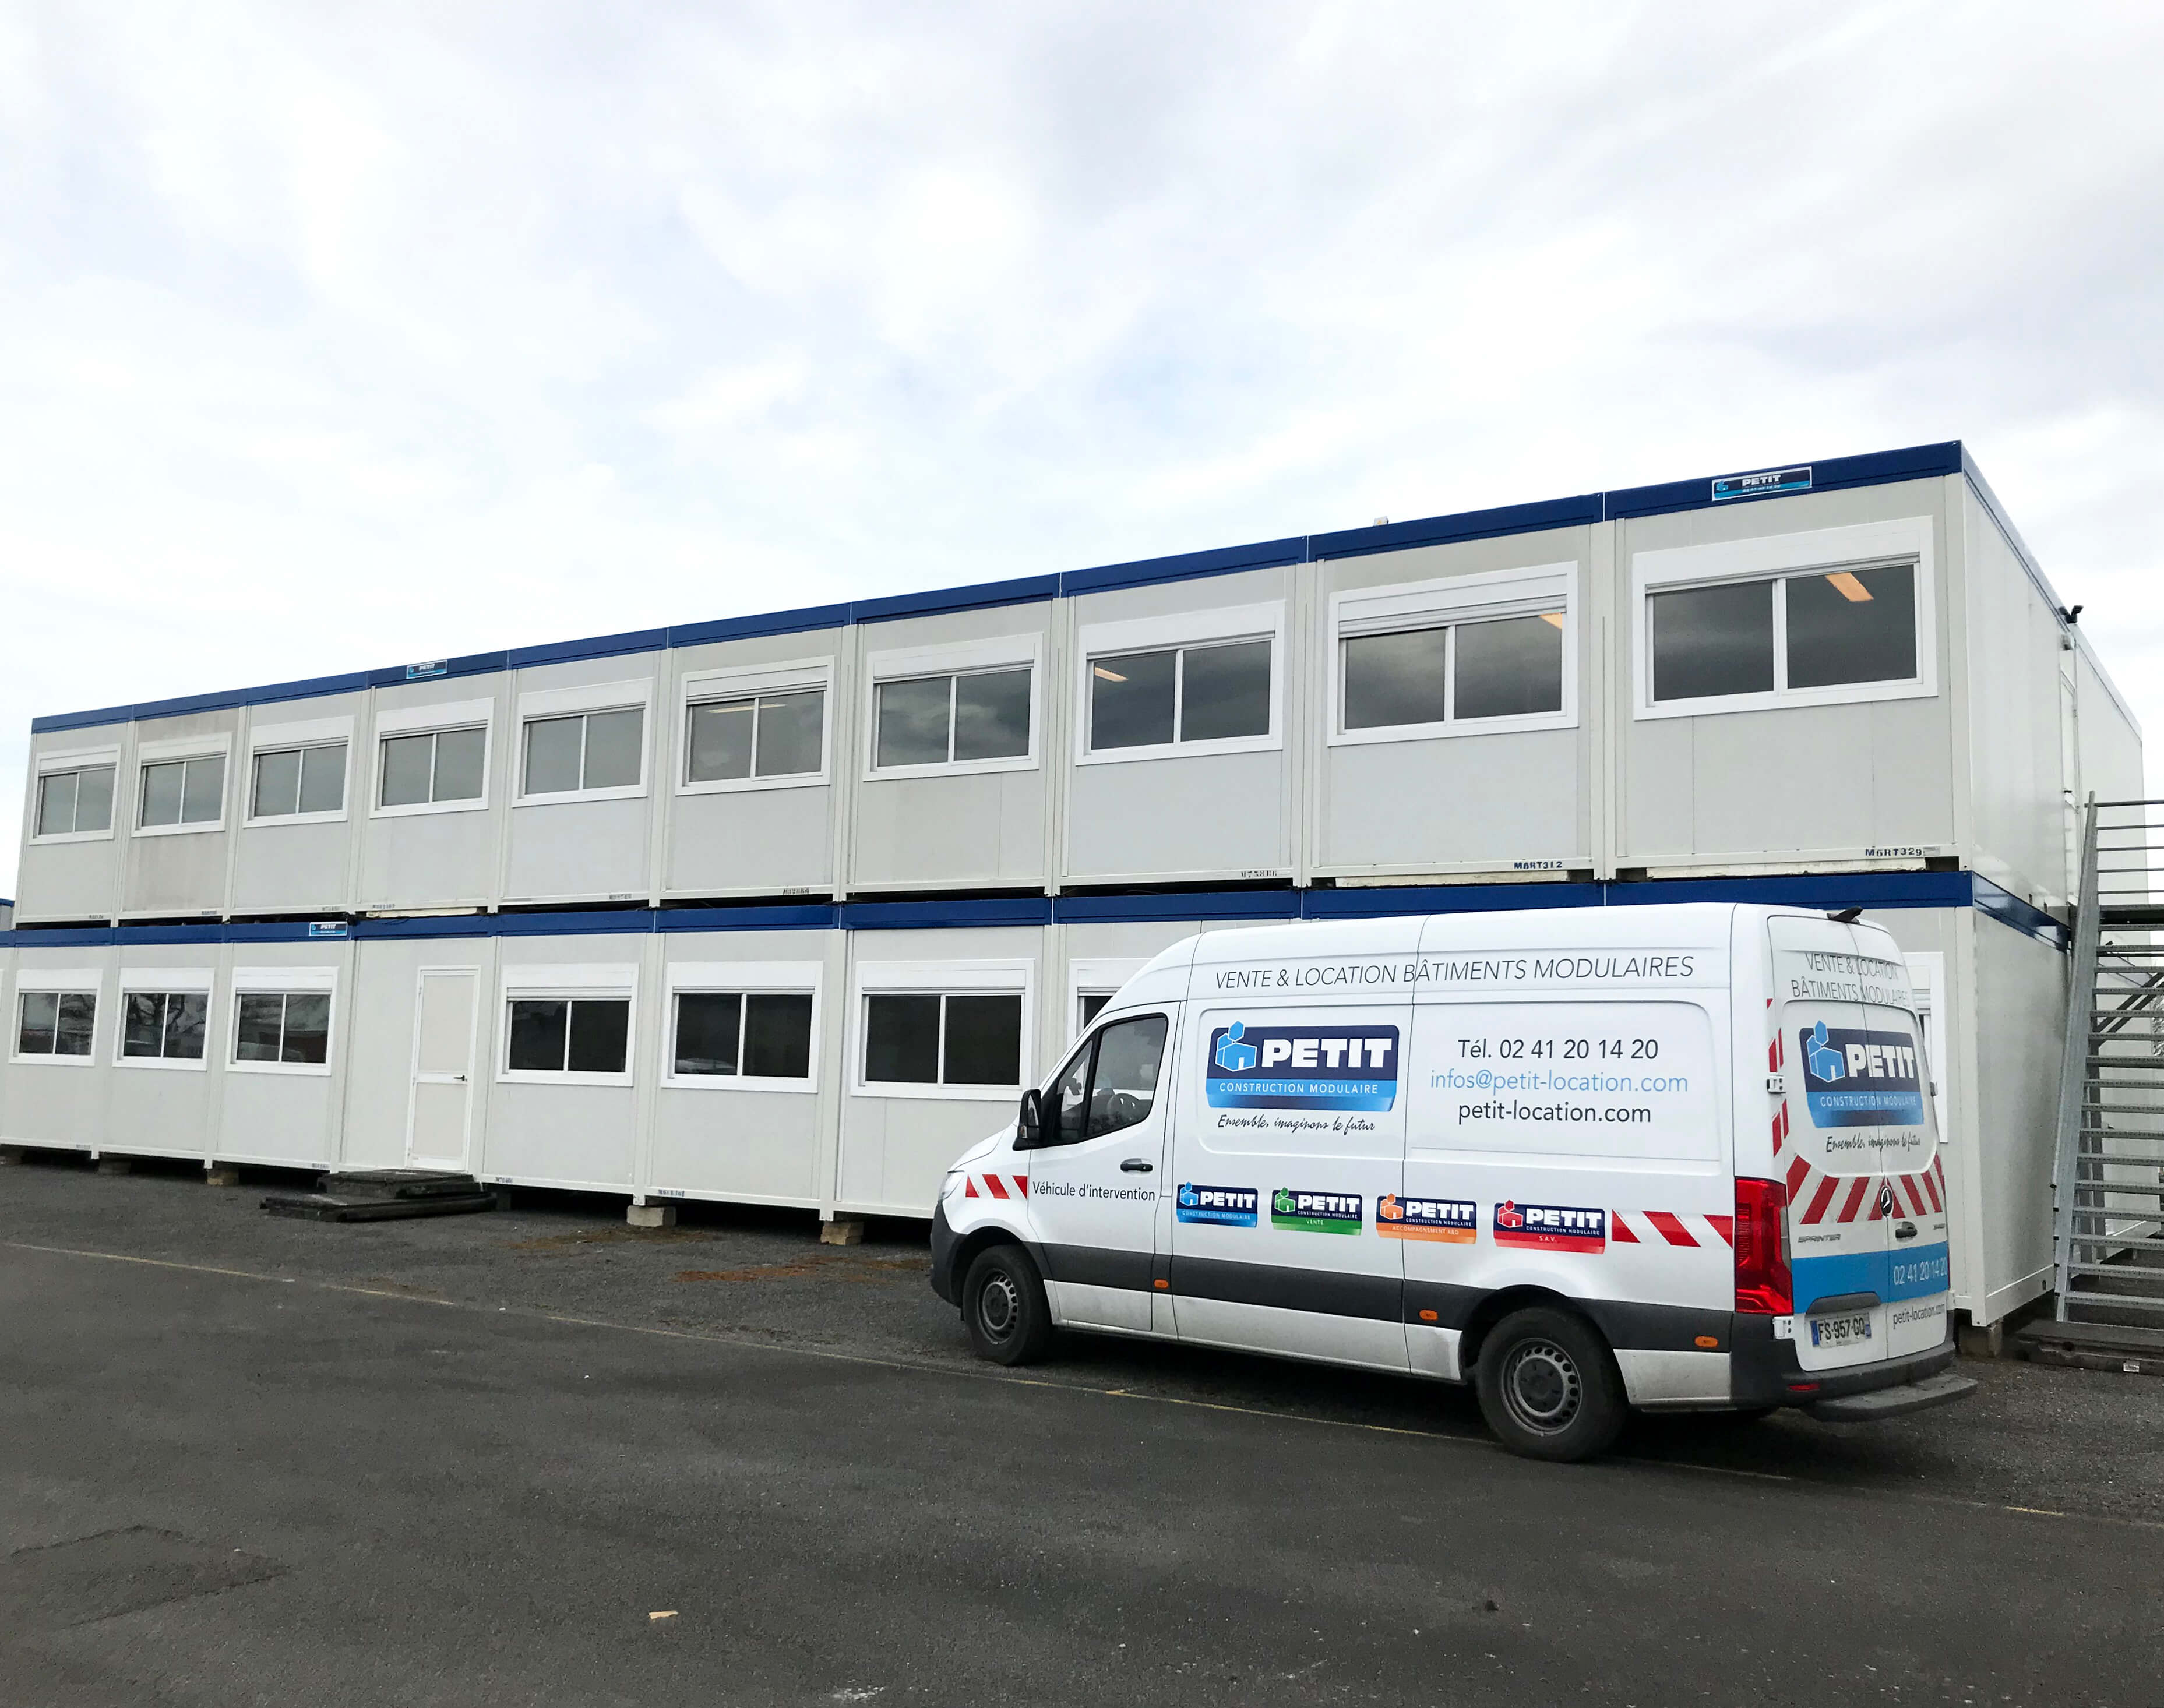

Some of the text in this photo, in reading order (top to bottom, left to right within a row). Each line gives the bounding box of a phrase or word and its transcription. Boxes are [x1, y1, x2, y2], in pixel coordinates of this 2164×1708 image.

[1742, 475, 1781, 486] PETIT
[1216, 955, 1695, 989] VENTE & LOCATION BÂTIMENTS MODULAIRES
[1805, 952, 1899, 979] VENTE & LOCATION
[1791, 976, 1859, 1002] BÂTIMENTS
[1261, 1037, 1393, 1068] PETIT
[1458, 1039, 1659, 1059] Tél. 02 41 20 14 20
[1845, 1043, 1915, 1078] PETIT
[1220, 1082, 1379, 1095] CONSTRUCTION MODULAIRE
[1430, 1068, 1689, 1096] infos@petit-location.com
[1820, 1096, 1882, 1107] CONSTRUCTION
[1458, 1100, 1651, 1125] petit-location.com
[1217, 1113, 1376, 1136] Ensemble, imaginons le futur
[1032, 1181, 1155, 1201] Véhicule d'intervention
[1200, 1191, 1256, 1208] PETIT
[1298, 1194, 1361, 1213] PETIT
[1405, 1201, 1474, 1220] PETIT
[1405, 1217, 1442, 1226] CONSTRUCTION
[1525, 1208, 1603, 1229] PETIT
[1525, 1224, 1600, 1236] CONSTRUCTION MODULAIRE
[1798, 1234, 1841, 1243] SPRINTER
[1894, 1265, 1905, 1285] 02
[1908, 1263, 1917, 1282] 41
[1920, 1261, 1930, 1280] 20
